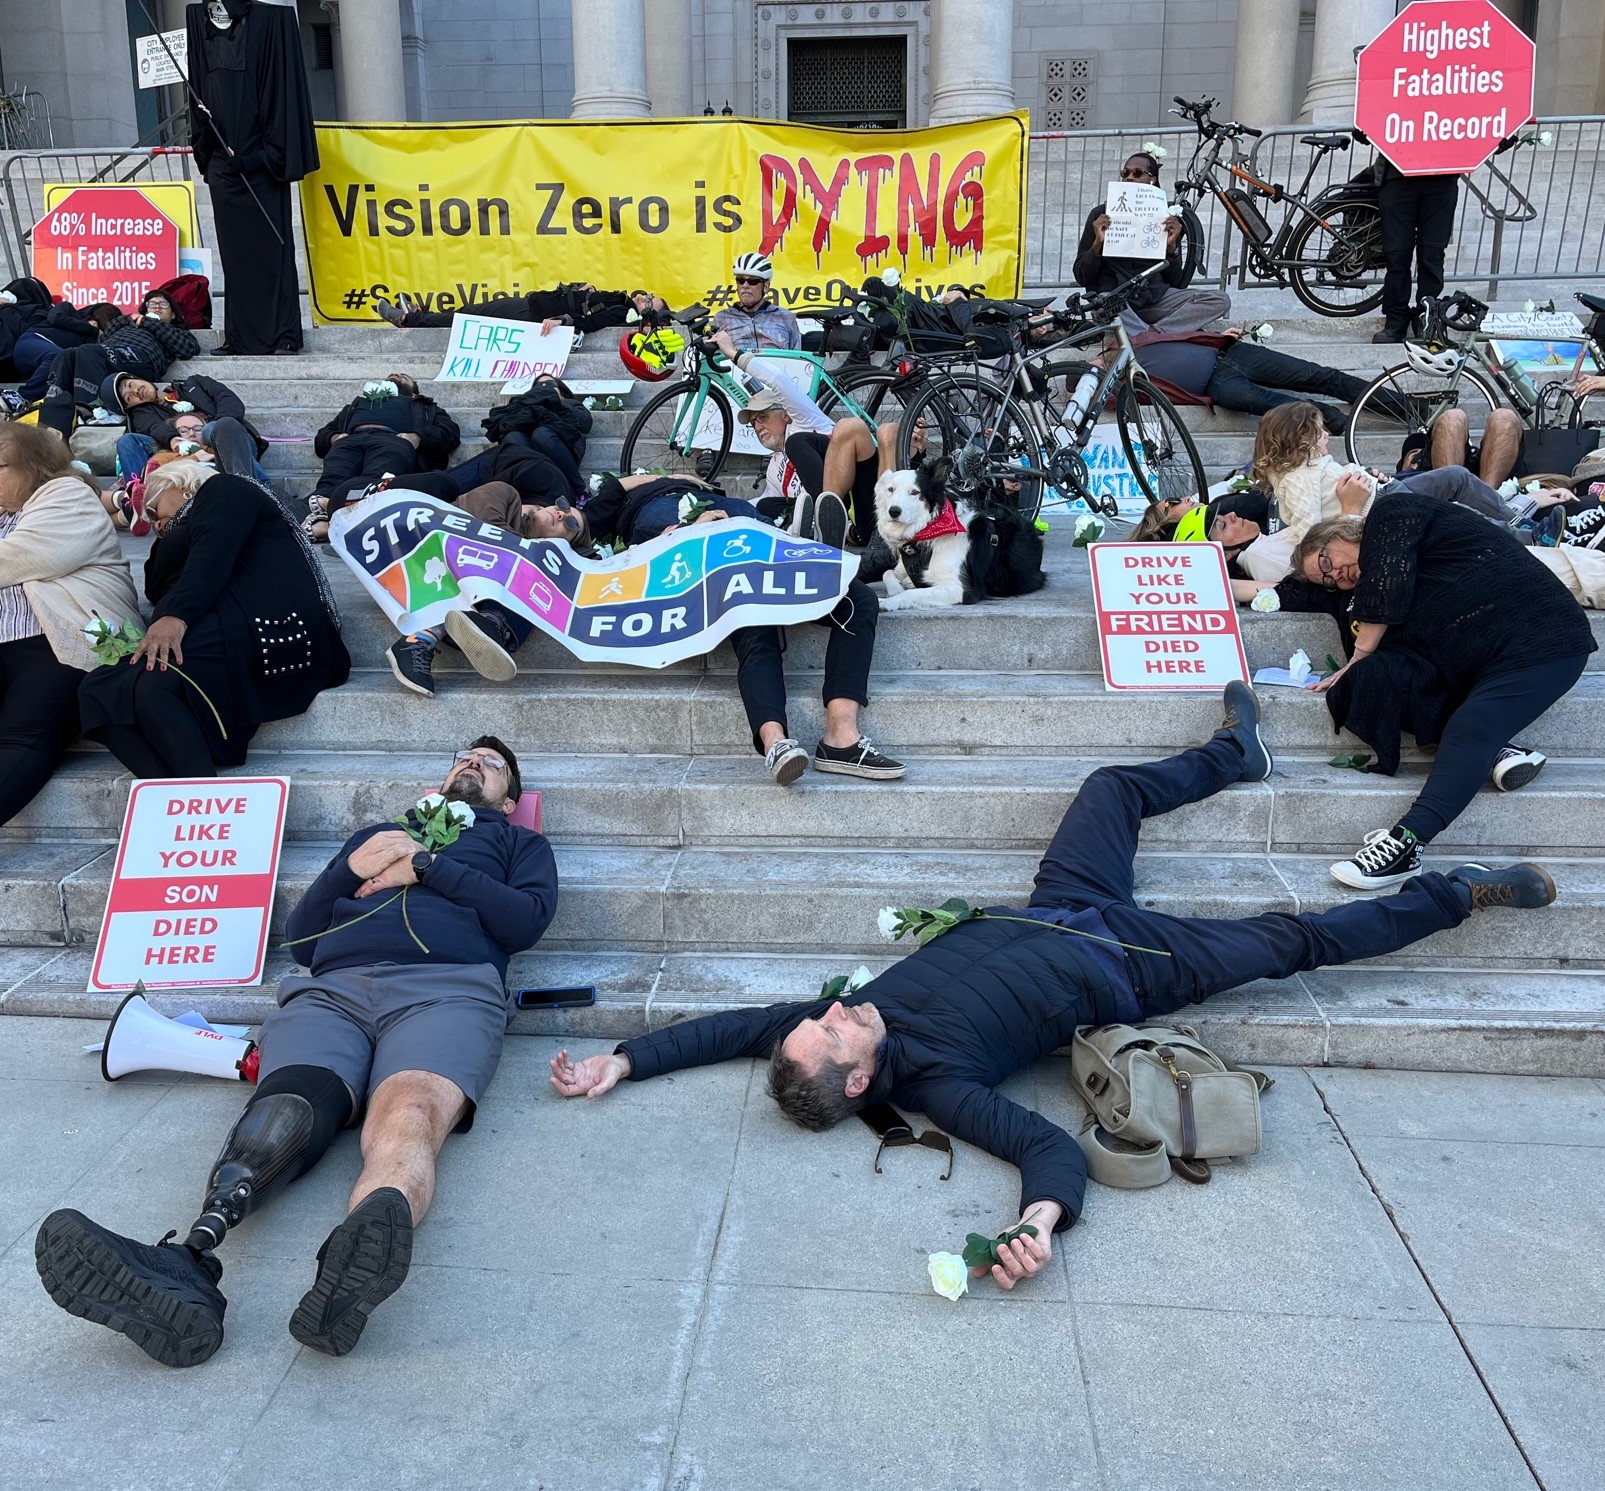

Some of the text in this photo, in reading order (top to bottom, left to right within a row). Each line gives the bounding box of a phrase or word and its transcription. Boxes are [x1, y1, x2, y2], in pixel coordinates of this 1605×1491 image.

[147, 43, 172, 55] ENTRANE
[160, 34, 185, 45] PLOYEE
[1402, 20, 1491, 59] Highest
[1392, 64, 1504, 98] Fatalities
[1384, 107, 1507, 144] On Record
[323, 151, 986, 274] Vision Zero is DYING
[50, 212, 163, 236] 68% Increase
[57, 246, 156, 271] In Fatalities
[62, 281, 151, 305] Since 2015
[459, 319, 525, 354] CARS
[446, 356, 481, 378] KILL
[362, 506, 563, 576] STREETS
[1123, 555, 1192, 568] DRIVE
[1137, 574, 1185, 586] LIKE
[590, 570, 819, 638] FOR ALL
[1129, 592, 1198, 605] YOUR
[1110, 613, 1226, 632] FRIEND
[1144, 640, 1200, 653] DIED
[1145, 660, 1206, 674] HERE
[166, 797, 247, 816] DRIVE
[174, 823, 231, 841] LIKE
[159, 849, 237, 868] YOUR
[164, 884, 219, 904] SON
[152, 917, 218, 937] DIED
[144, 945, 217, 966] HERE
[194, 1030, 224, 1040] PYLE
